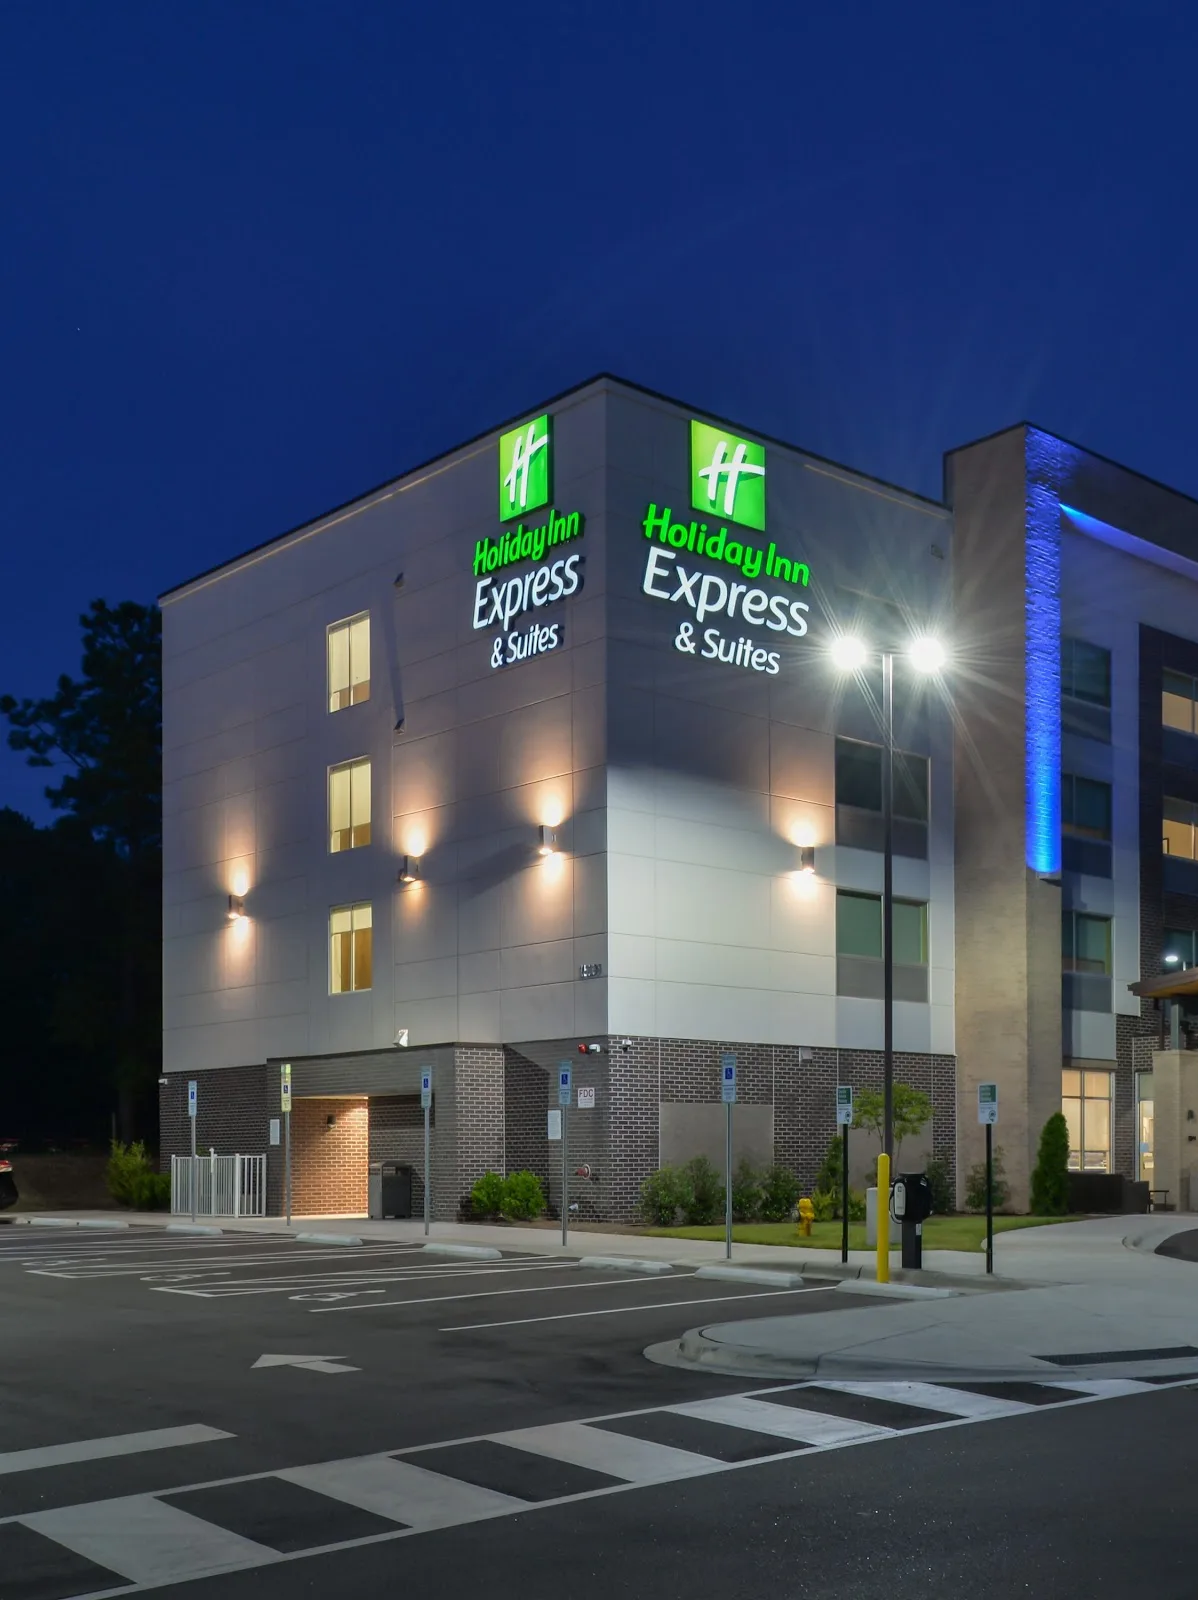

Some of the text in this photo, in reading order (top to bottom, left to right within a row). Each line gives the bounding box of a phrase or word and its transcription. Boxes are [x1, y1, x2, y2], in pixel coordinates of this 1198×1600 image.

[473, 509, 580, 576] Holiday Inn
[642, 503, 810, 587] Holiday Inn
[473, 554, 580, 631] Express
[643, 546, 810, 637] Express
[490, 623, 559, 669] & Suites
[674, 621, 781, 675] & Suites
[578, 1088, 594, 1098] FDC
